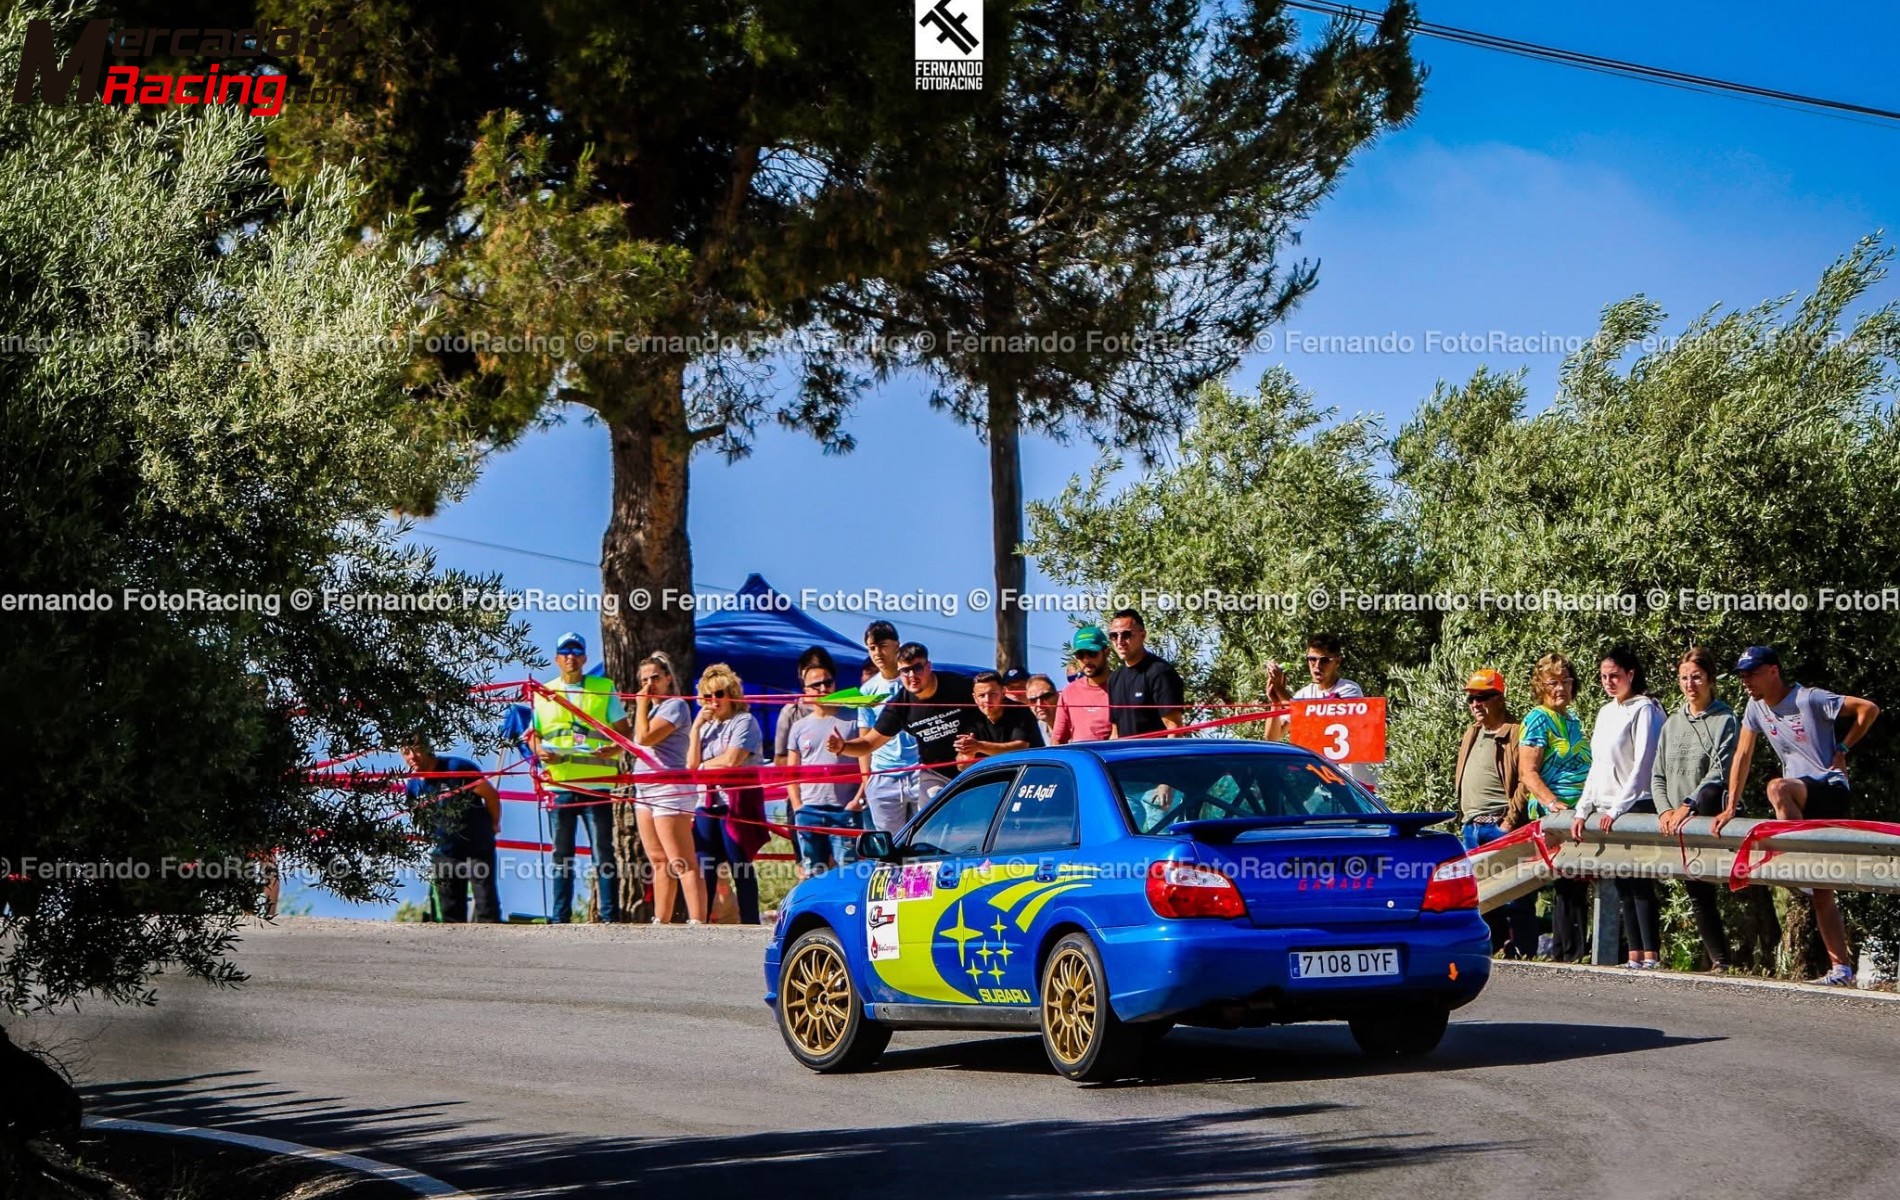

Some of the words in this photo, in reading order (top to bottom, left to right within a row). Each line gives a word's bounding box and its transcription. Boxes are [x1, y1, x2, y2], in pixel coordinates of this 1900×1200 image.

[1305, 703, 1368, 716] PUESTO
[916, 720, 960, 737] TECHNO
[923, 728, 958, 742] OSCURO
[1323, 723, 1350, 760] 3
[1306, 763, 1345, 786] 14
[870, 868, 889, 900] 14
[1298, 877, 1375, 892] GARAGE
[1303, 954, 1352, 975] 7108
[1358, 952, 1393, 973] DYF
[978, 988, 1031, 1003] SUBARU
